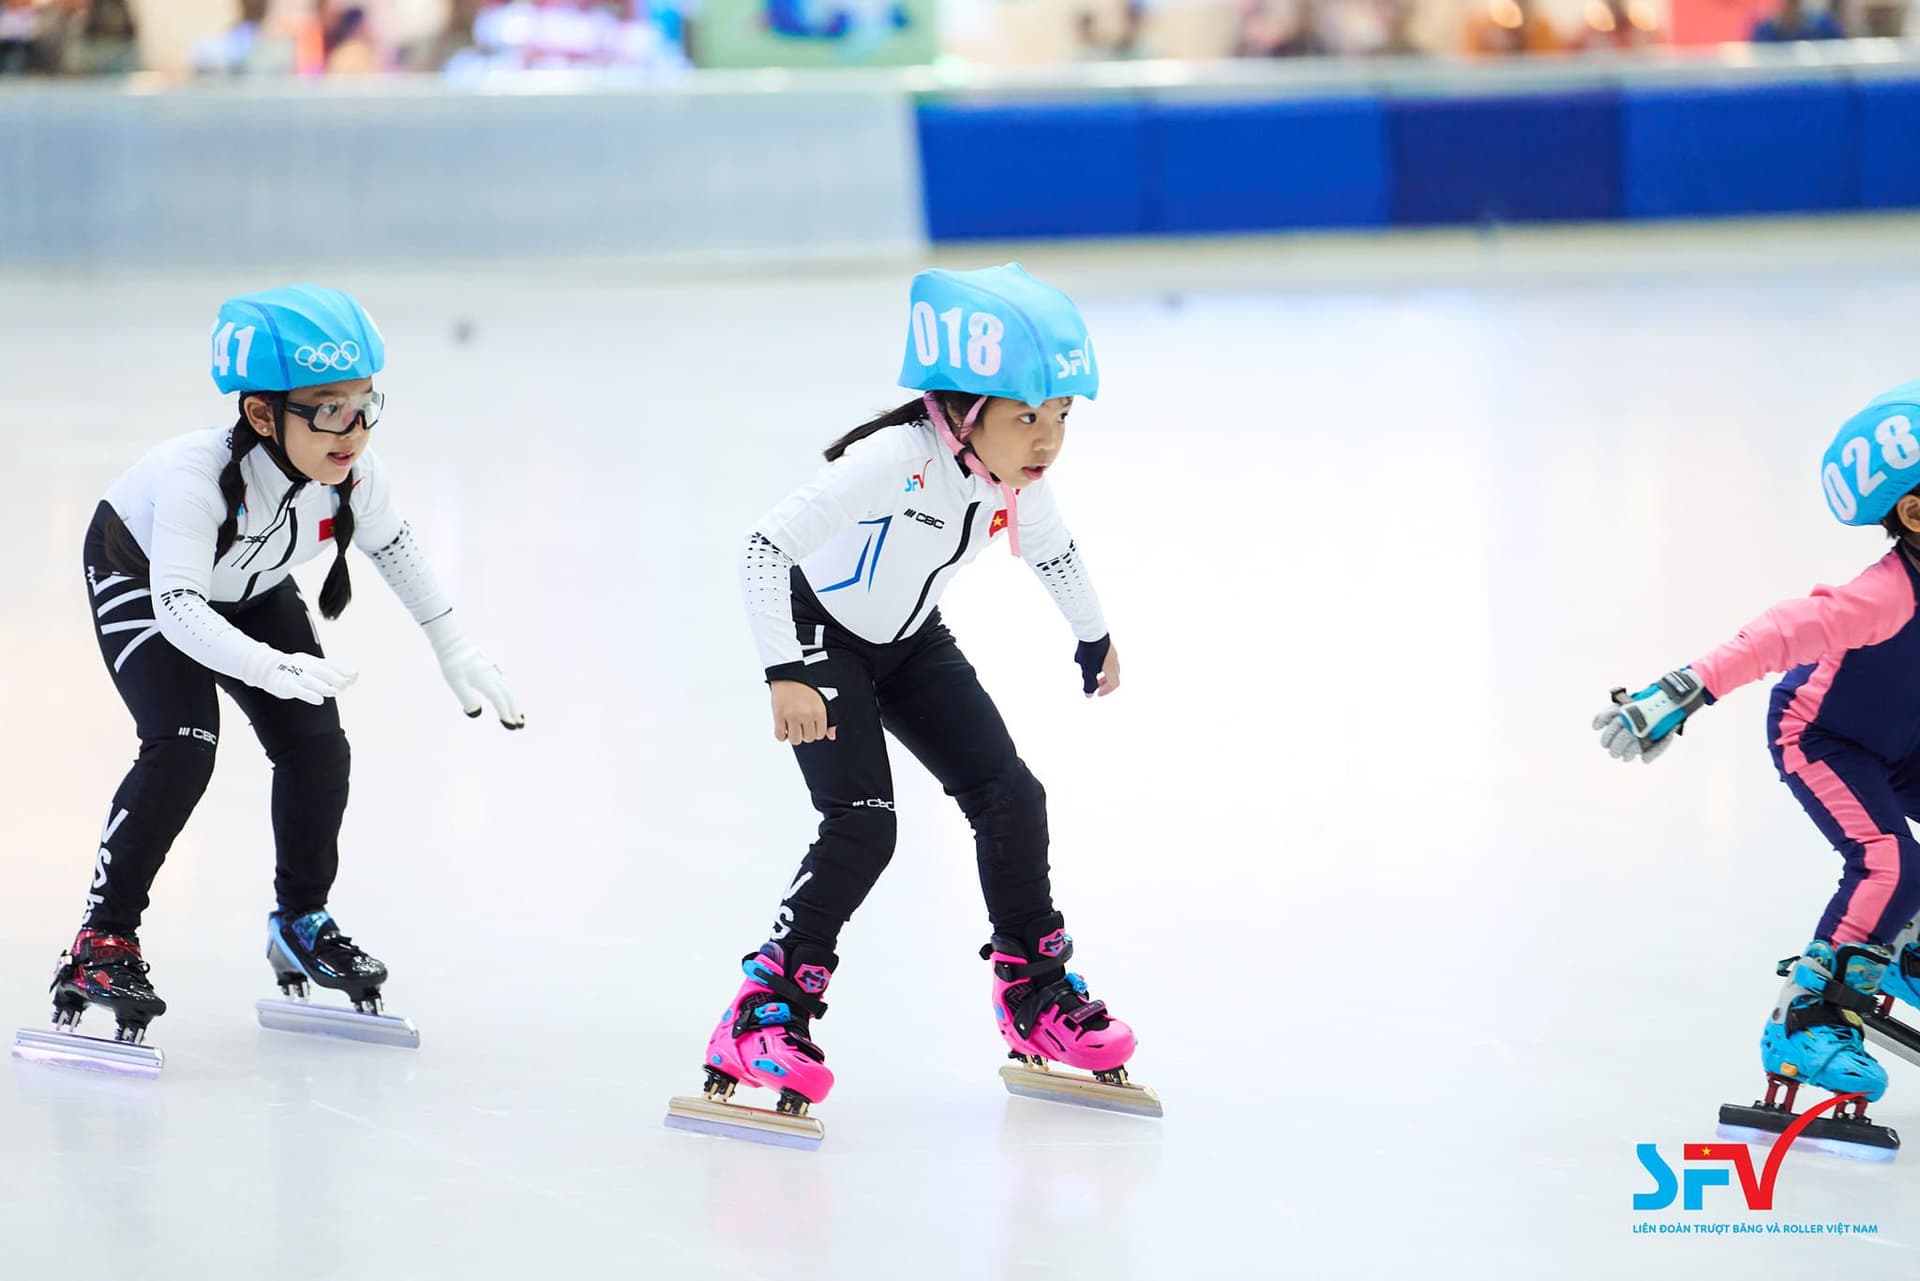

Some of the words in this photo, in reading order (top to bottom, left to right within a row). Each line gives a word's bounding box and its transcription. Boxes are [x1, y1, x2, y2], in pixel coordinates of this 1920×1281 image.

[212, 317, 256, 378] 41
[912, 301, 1004, 376] 018
[1055, 335, 1091, 379] SFV
[905, 458, 933, 492] SFV
[1823, 414, 1920, 521] 028
[915, 512, 945, 530] CBC
